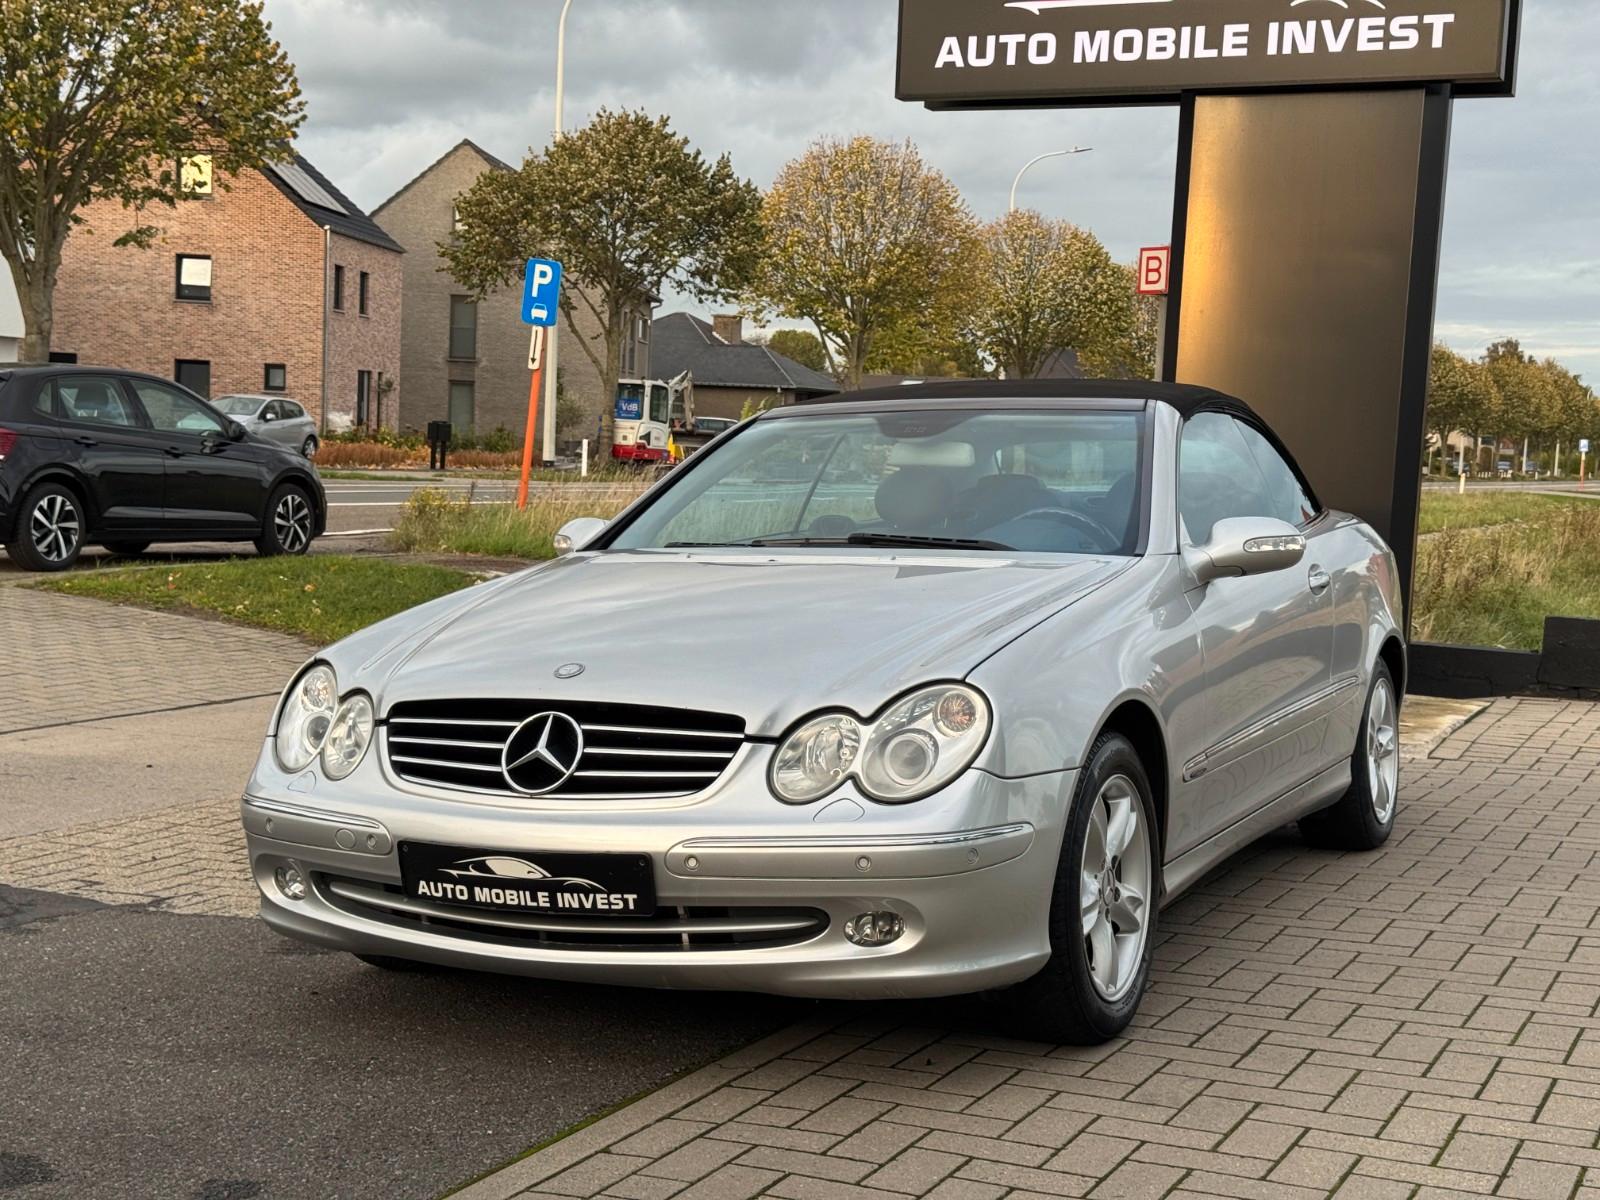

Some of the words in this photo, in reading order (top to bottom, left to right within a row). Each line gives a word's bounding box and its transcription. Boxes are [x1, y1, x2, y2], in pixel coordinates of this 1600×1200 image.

[934, 32, 1057, 69] AUTO
[1073, 23, 1249, 64] MOBILE
[1266, 13, 1455, 56] INVEST
[531, 263, 553, 298] P
[1145, 255, 1162, 285] B
[621, 402, 639, 412] VdB
[417, 880, 469, 901] AUTO
[474, 887, 551, 907] MOBILE
[557, 892, 638, 910] INVEST
